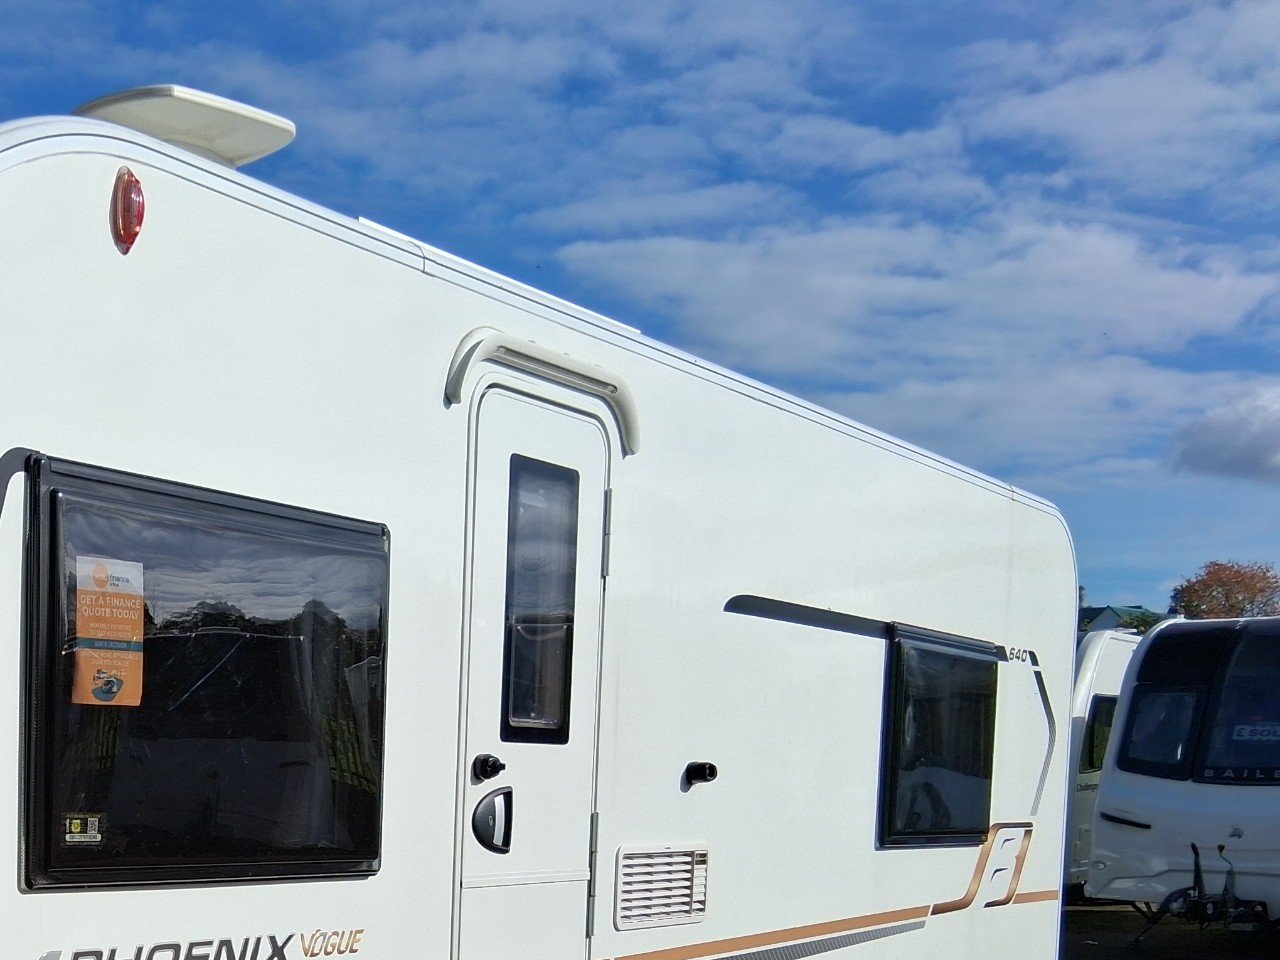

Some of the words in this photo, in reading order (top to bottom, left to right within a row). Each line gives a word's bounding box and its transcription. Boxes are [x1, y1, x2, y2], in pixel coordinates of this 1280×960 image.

[80, 595, 96, 605] GET
[98, 596, 104, 604] A
[106, 596, 141, 608] FINANCE
[82, 606, 110, 617] QUOTE
[111, 608, 139, 619] TODAY
[1009, 647, 1028, 662] 640
[300, 928, 365, 958] VOGUE
